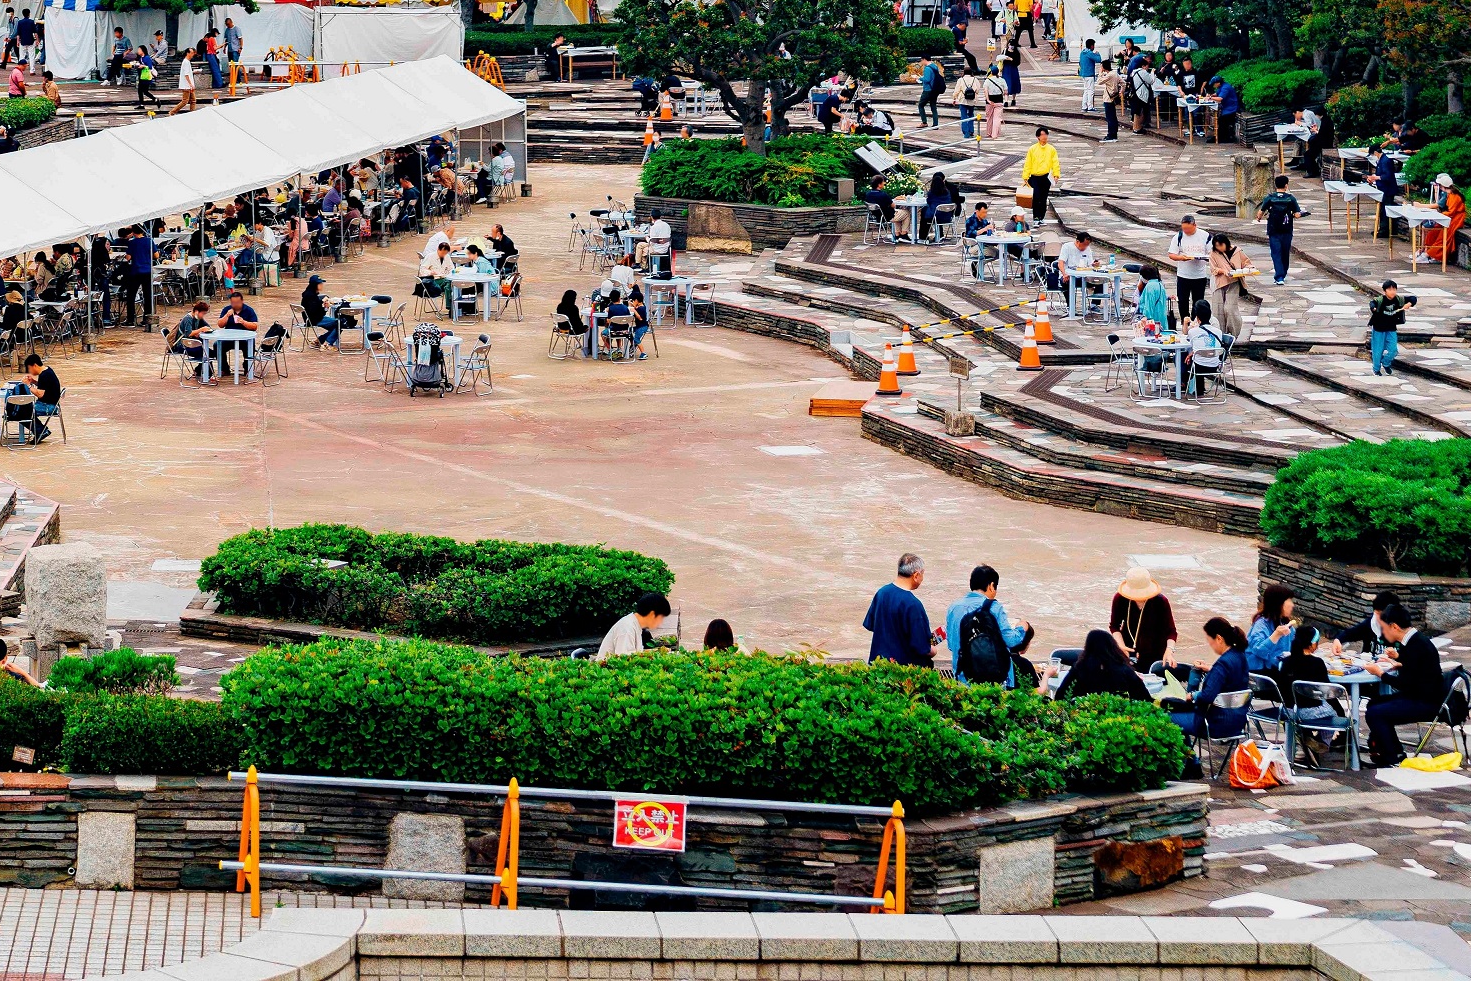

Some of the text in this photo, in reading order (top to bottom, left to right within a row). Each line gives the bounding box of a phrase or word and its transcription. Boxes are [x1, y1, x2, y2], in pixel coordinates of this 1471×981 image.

[622, 808, 680, 825] 立入禁止
[625, 827, 675, 837] KEEP OUT
